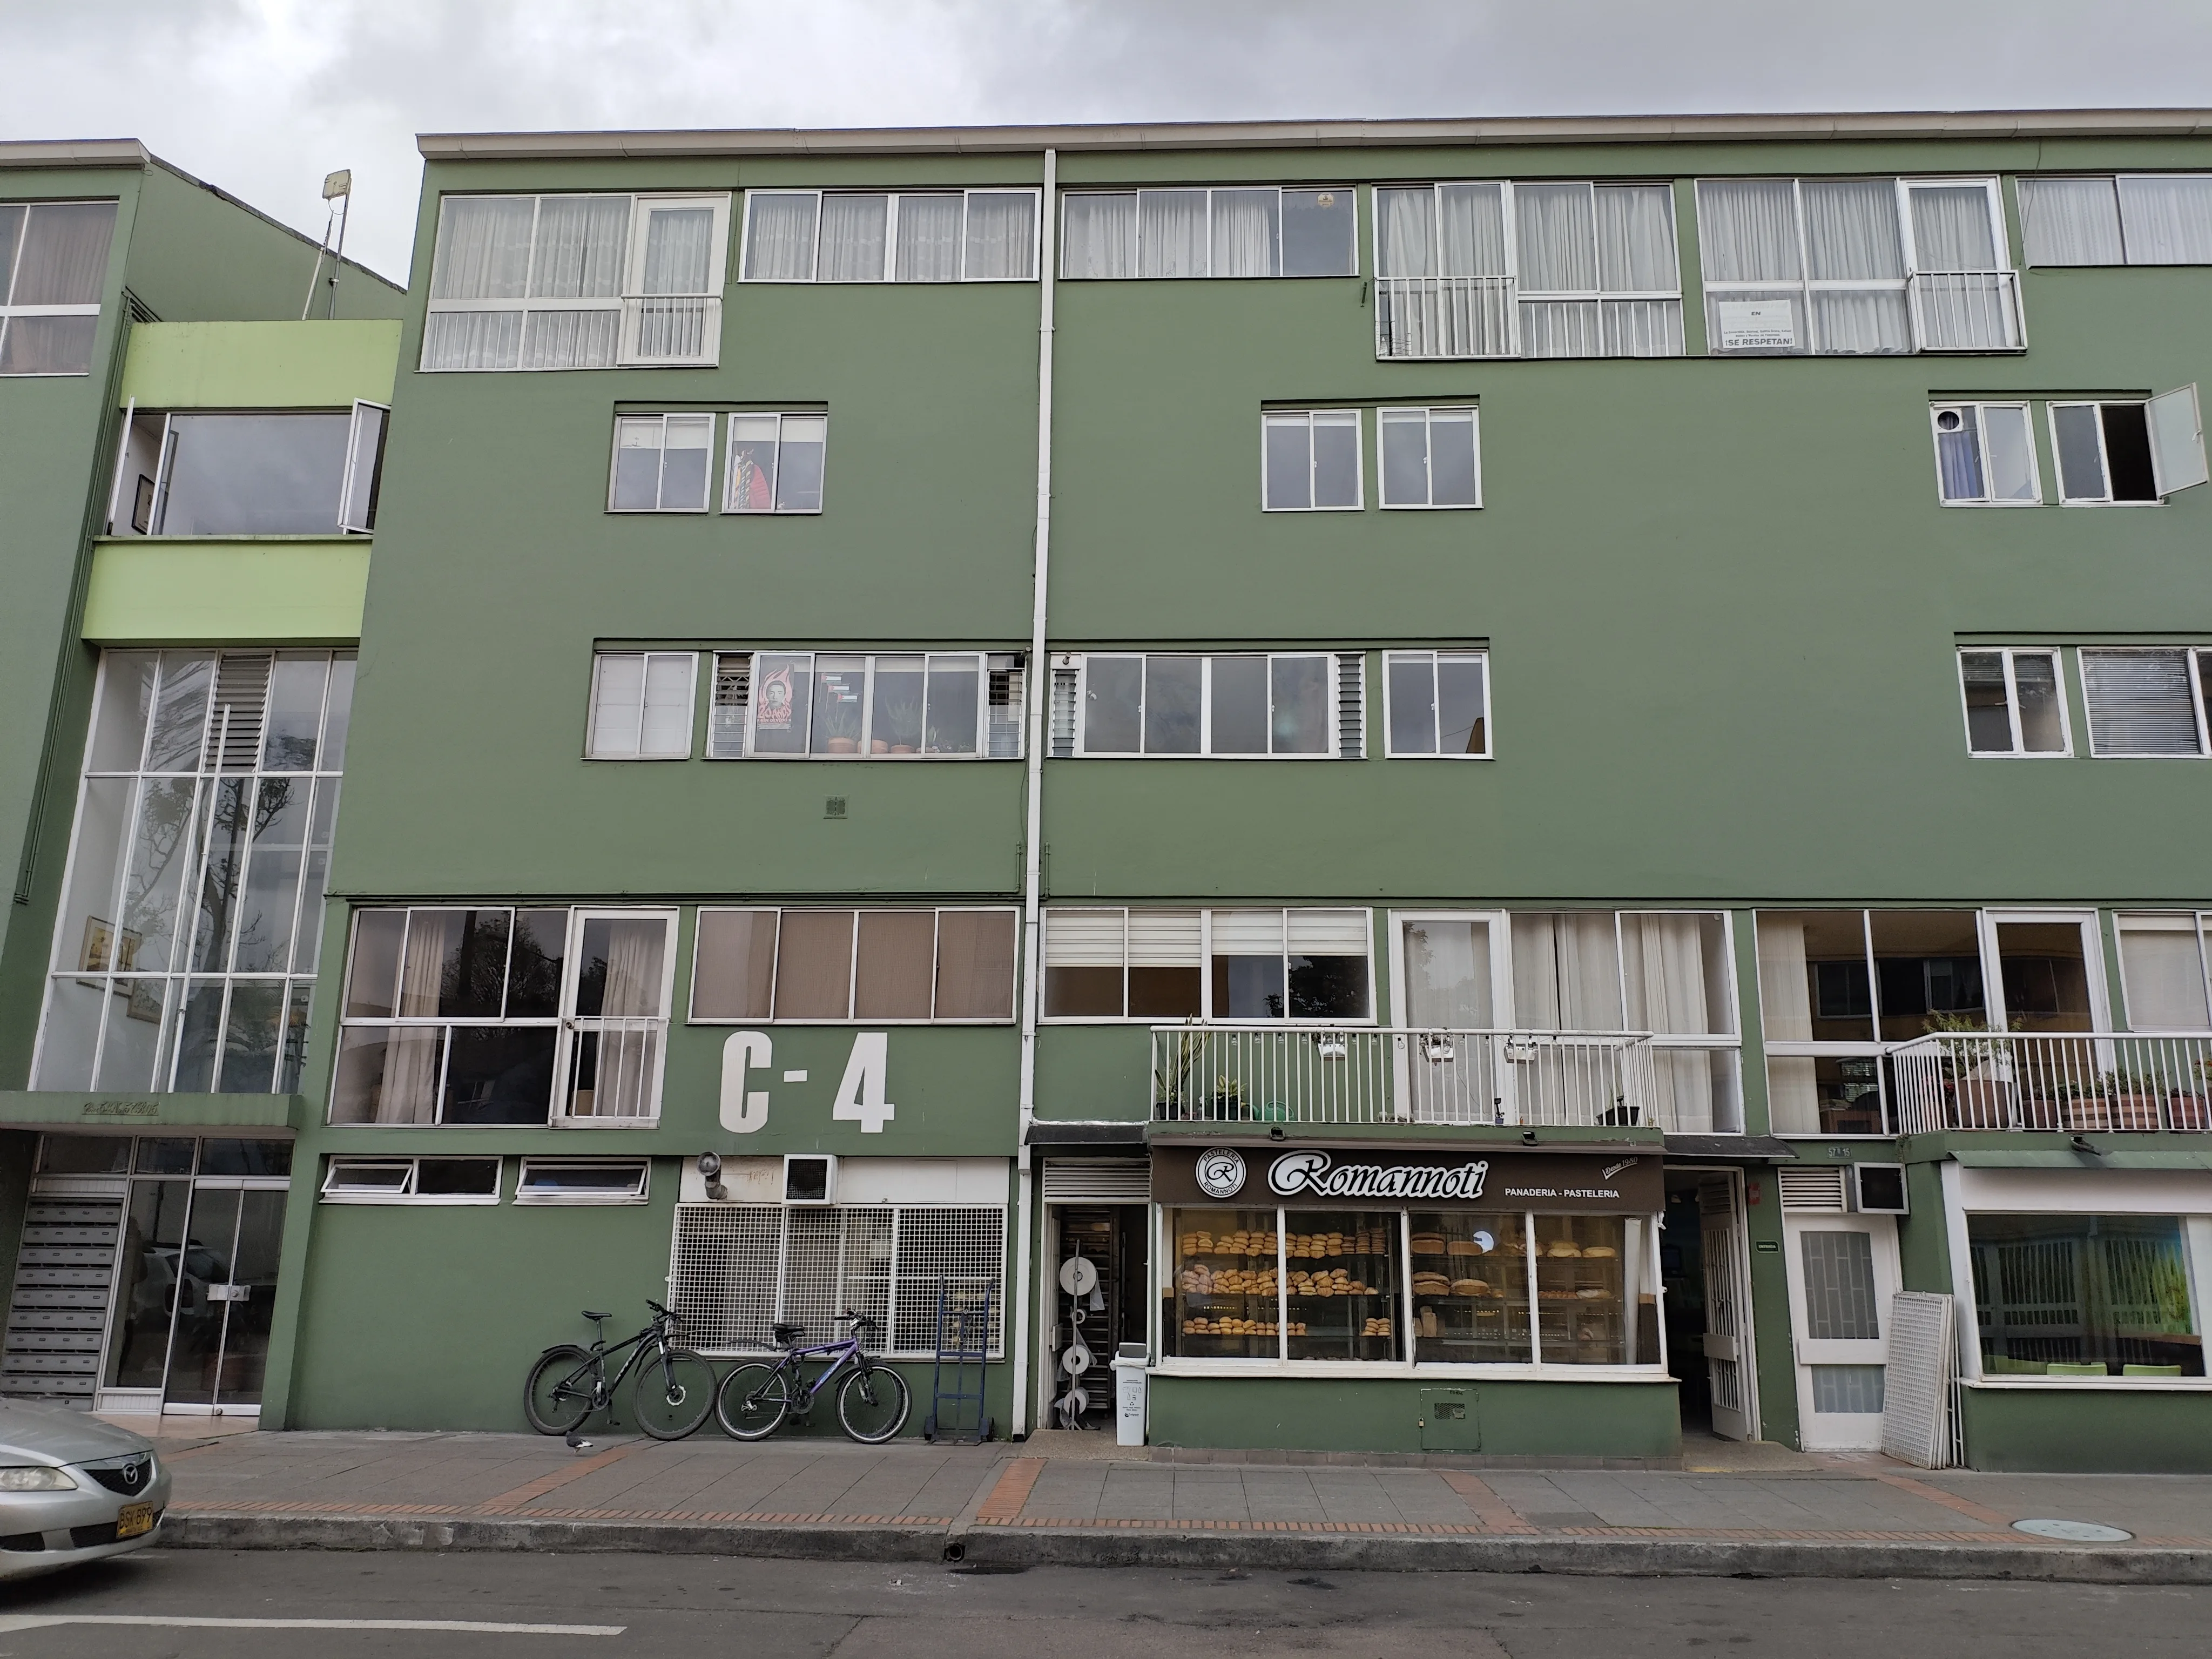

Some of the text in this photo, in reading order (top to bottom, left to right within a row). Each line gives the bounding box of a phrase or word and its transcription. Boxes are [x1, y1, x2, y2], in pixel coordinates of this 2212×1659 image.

[1742, 338, 1792, 346] RESPETAN!
[1203, 1149, 1239, 1164] PASTELERIA
[1828, 1148, 1836, 1156] 57
[1842, 1148, 1850, 1156] 15
[1605, 1157, 1638, 1174] Desde 1980
[1270, 1150, 1488, 1198] Romannoti
[1203, 1182, 1237, 1194] ROMANNOTI
[1505, 1188, 1557, 1197] PANADERIA
[1564, 1189, 1620, 1198] PASTELERIA
